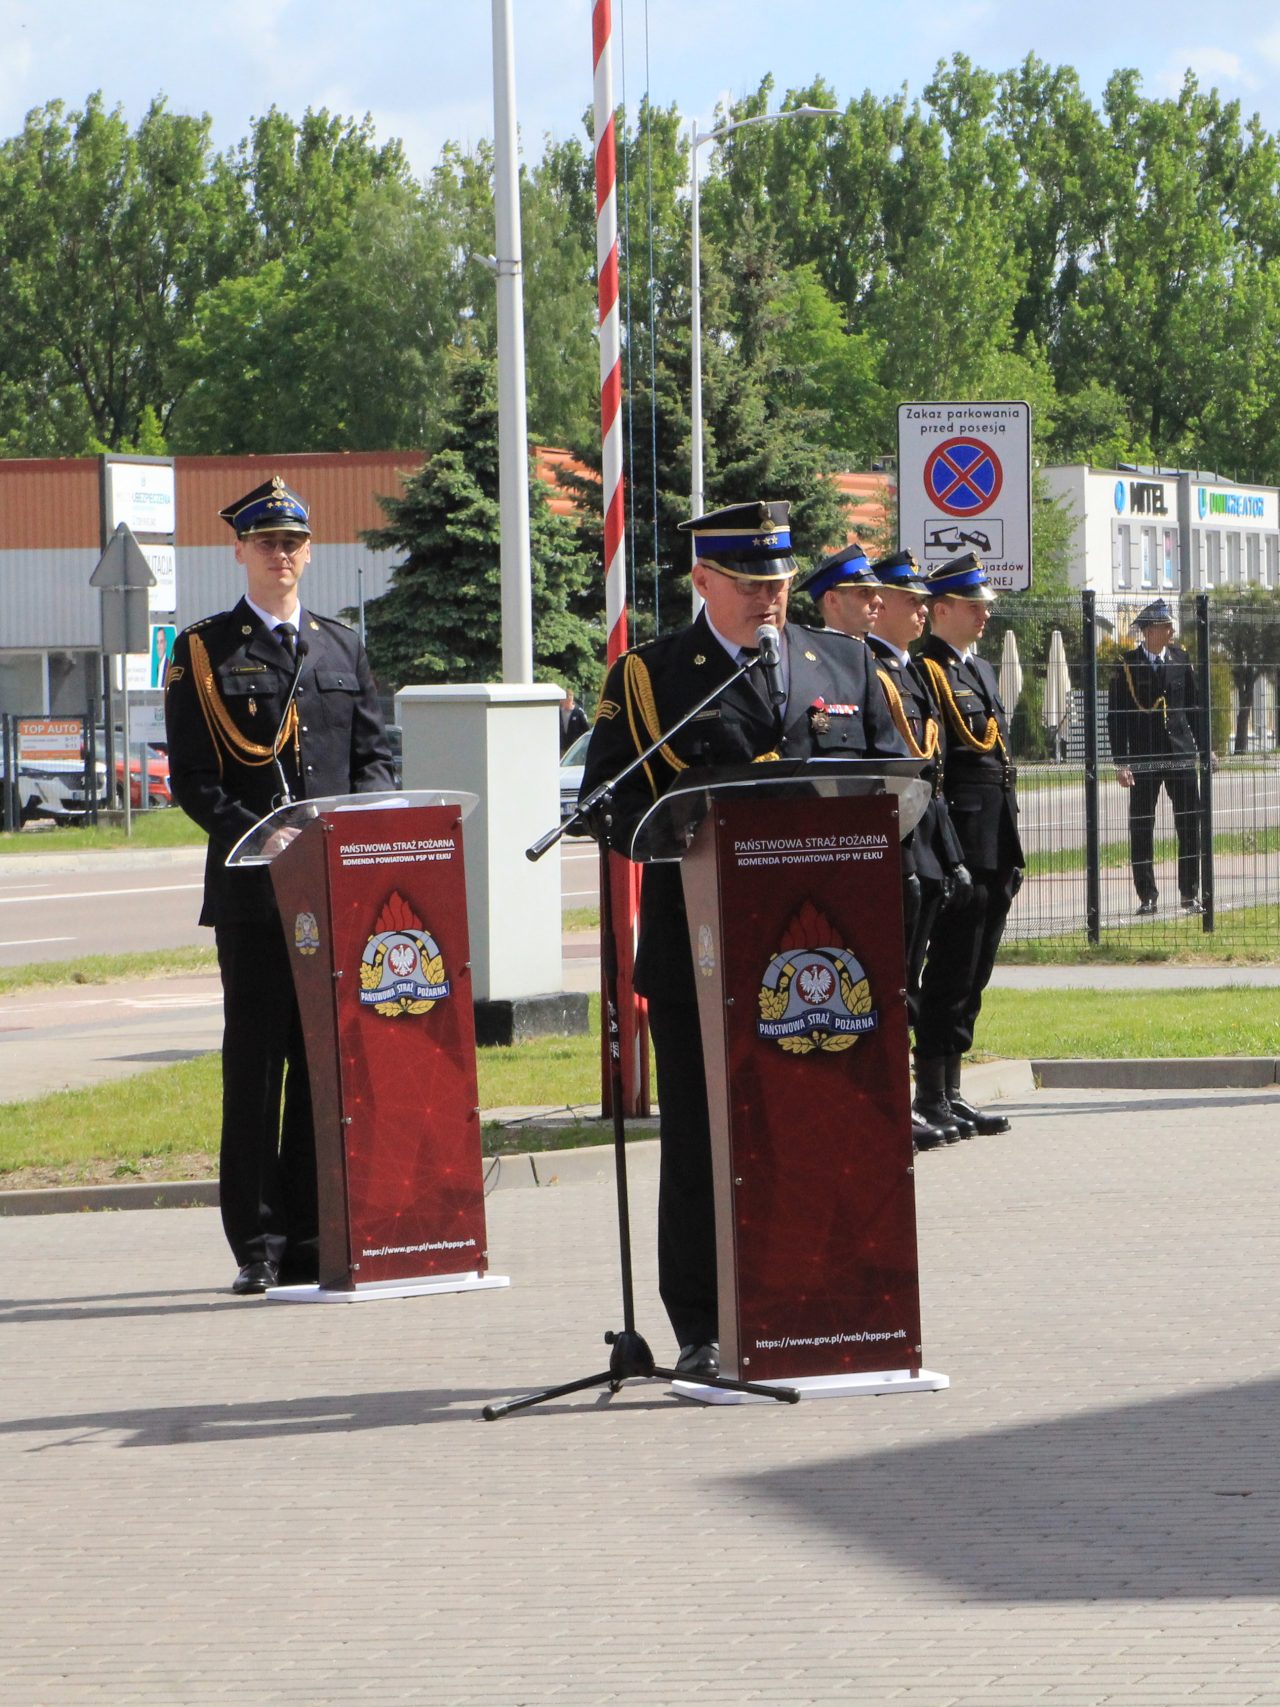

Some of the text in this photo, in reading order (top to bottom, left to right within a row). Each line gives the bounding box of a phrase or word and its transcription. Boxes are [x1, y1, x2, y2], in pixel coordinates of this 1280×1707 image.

[906, 407, 1020, 421] Zakaz parkowania
[920, 422, 954, 436] przed
[1130, 482, 1168, 515] MITEL
[1210, 492, 1264, 517] UNIKREATOR
[23, 724, 78, 734] TOP AUTO
[340, 838, 455, 854] PAŃSTWOWA STRAŻ POŻARNA
[734, 834, 888, 851] PAŃSTWOWA STRAŻ POŻARNA
[343, 857, 375, 866] KOMENDA
[375, 855, 415, 864] POWIATOWA
[415, 854, 427, 862] PSP
[738, 856, 780, 866] KOMENDA
[781, 854, 834, 864] POWIATOWA
[835, 853, 851, 861] PSP
[863, 851, 883, 860] EŁKU
[360, 982, 447, 1002] PAŃSTWOWA STRAŻ POŻARNA
[759, 1012, 874, 1035] PAŃSTWOWA STRAŻ POŻARNA
[362, 1238, 476, 1257] https://www.gov.pl/web/kppsp-elk
[756, 1329, 906, 1349] https://www.gov.pl/web/kppsp-elk
